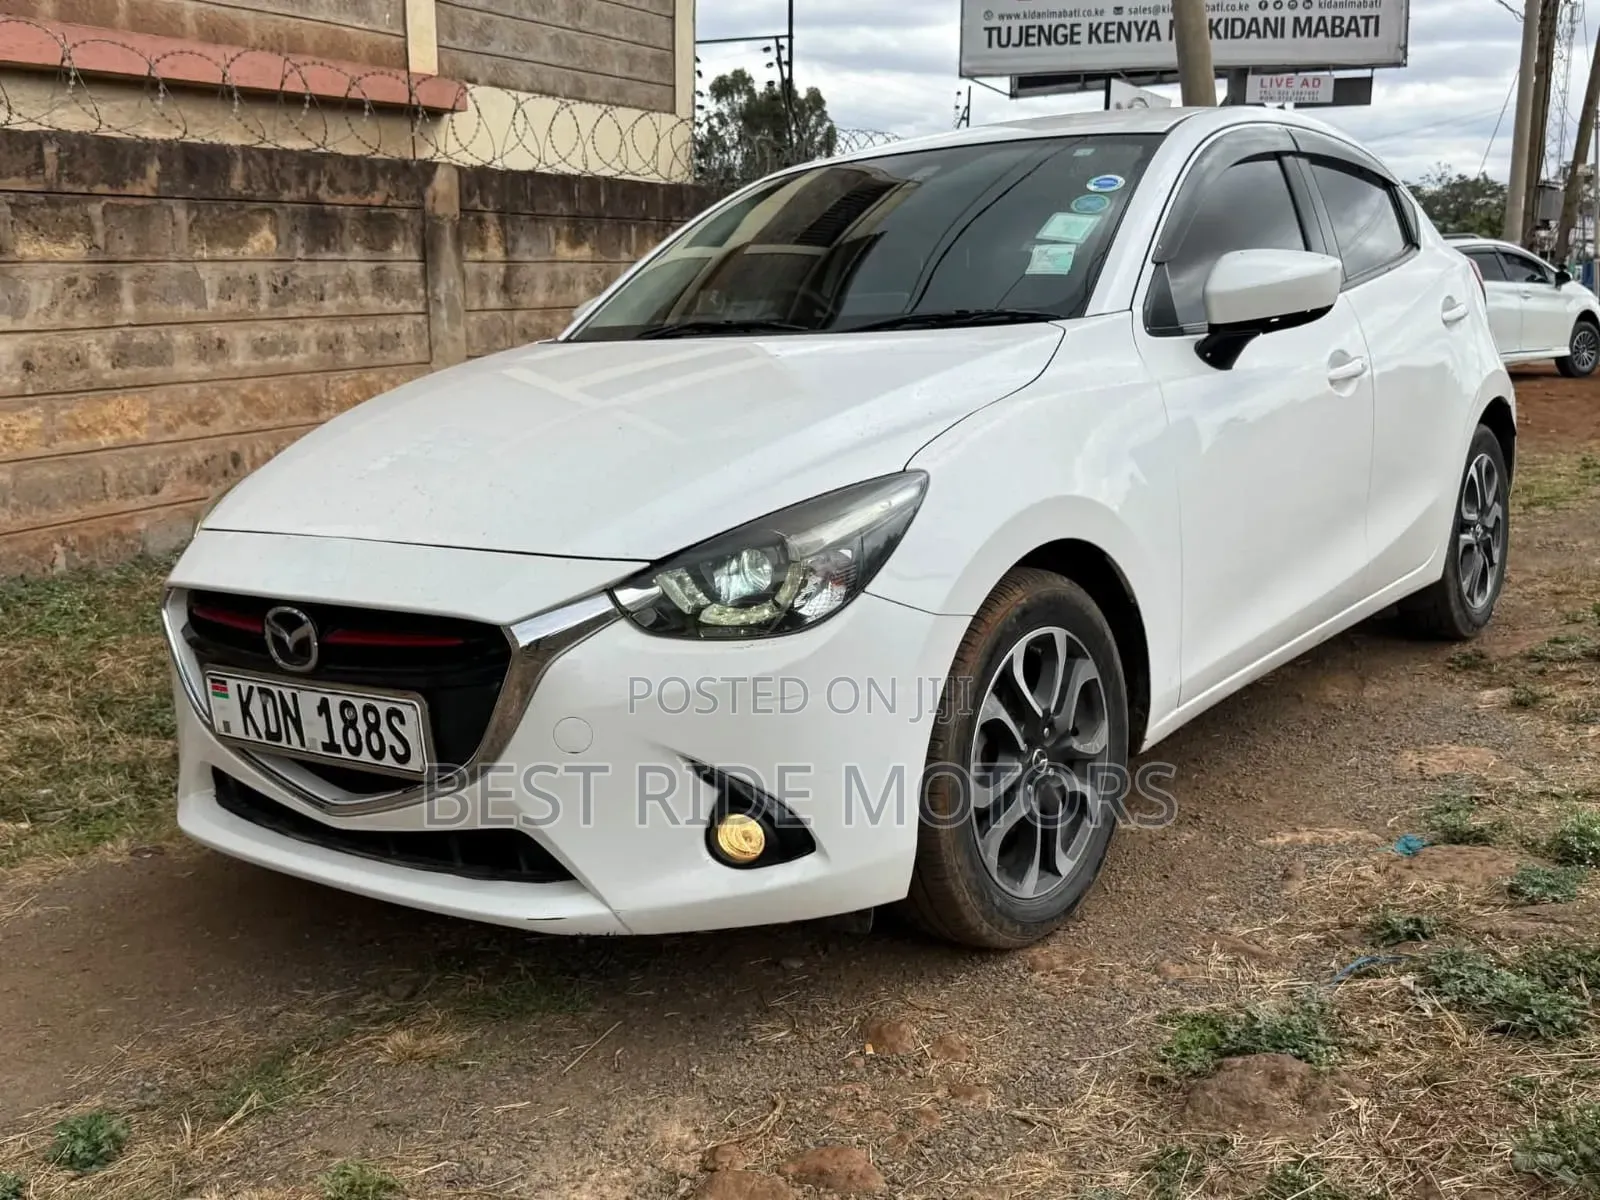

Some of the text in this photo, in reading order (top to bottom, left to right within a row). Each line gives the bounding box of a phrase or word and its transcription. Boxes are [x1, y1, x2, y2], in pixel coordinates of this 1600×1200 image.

[998, 8, 1104, 21] www.kidanimabati.co.ke
[984, 24, 1082, 48] TUJENGE
[1087, 20, 1162, 44] KENYA
[1208, 16, 1285, 40] KIDANI
[1292, 15, 1380, 38] MABATI
[1260, 78, 1321, 88] LIVE AD
[236, 682, 412, 765] KDN 188S
